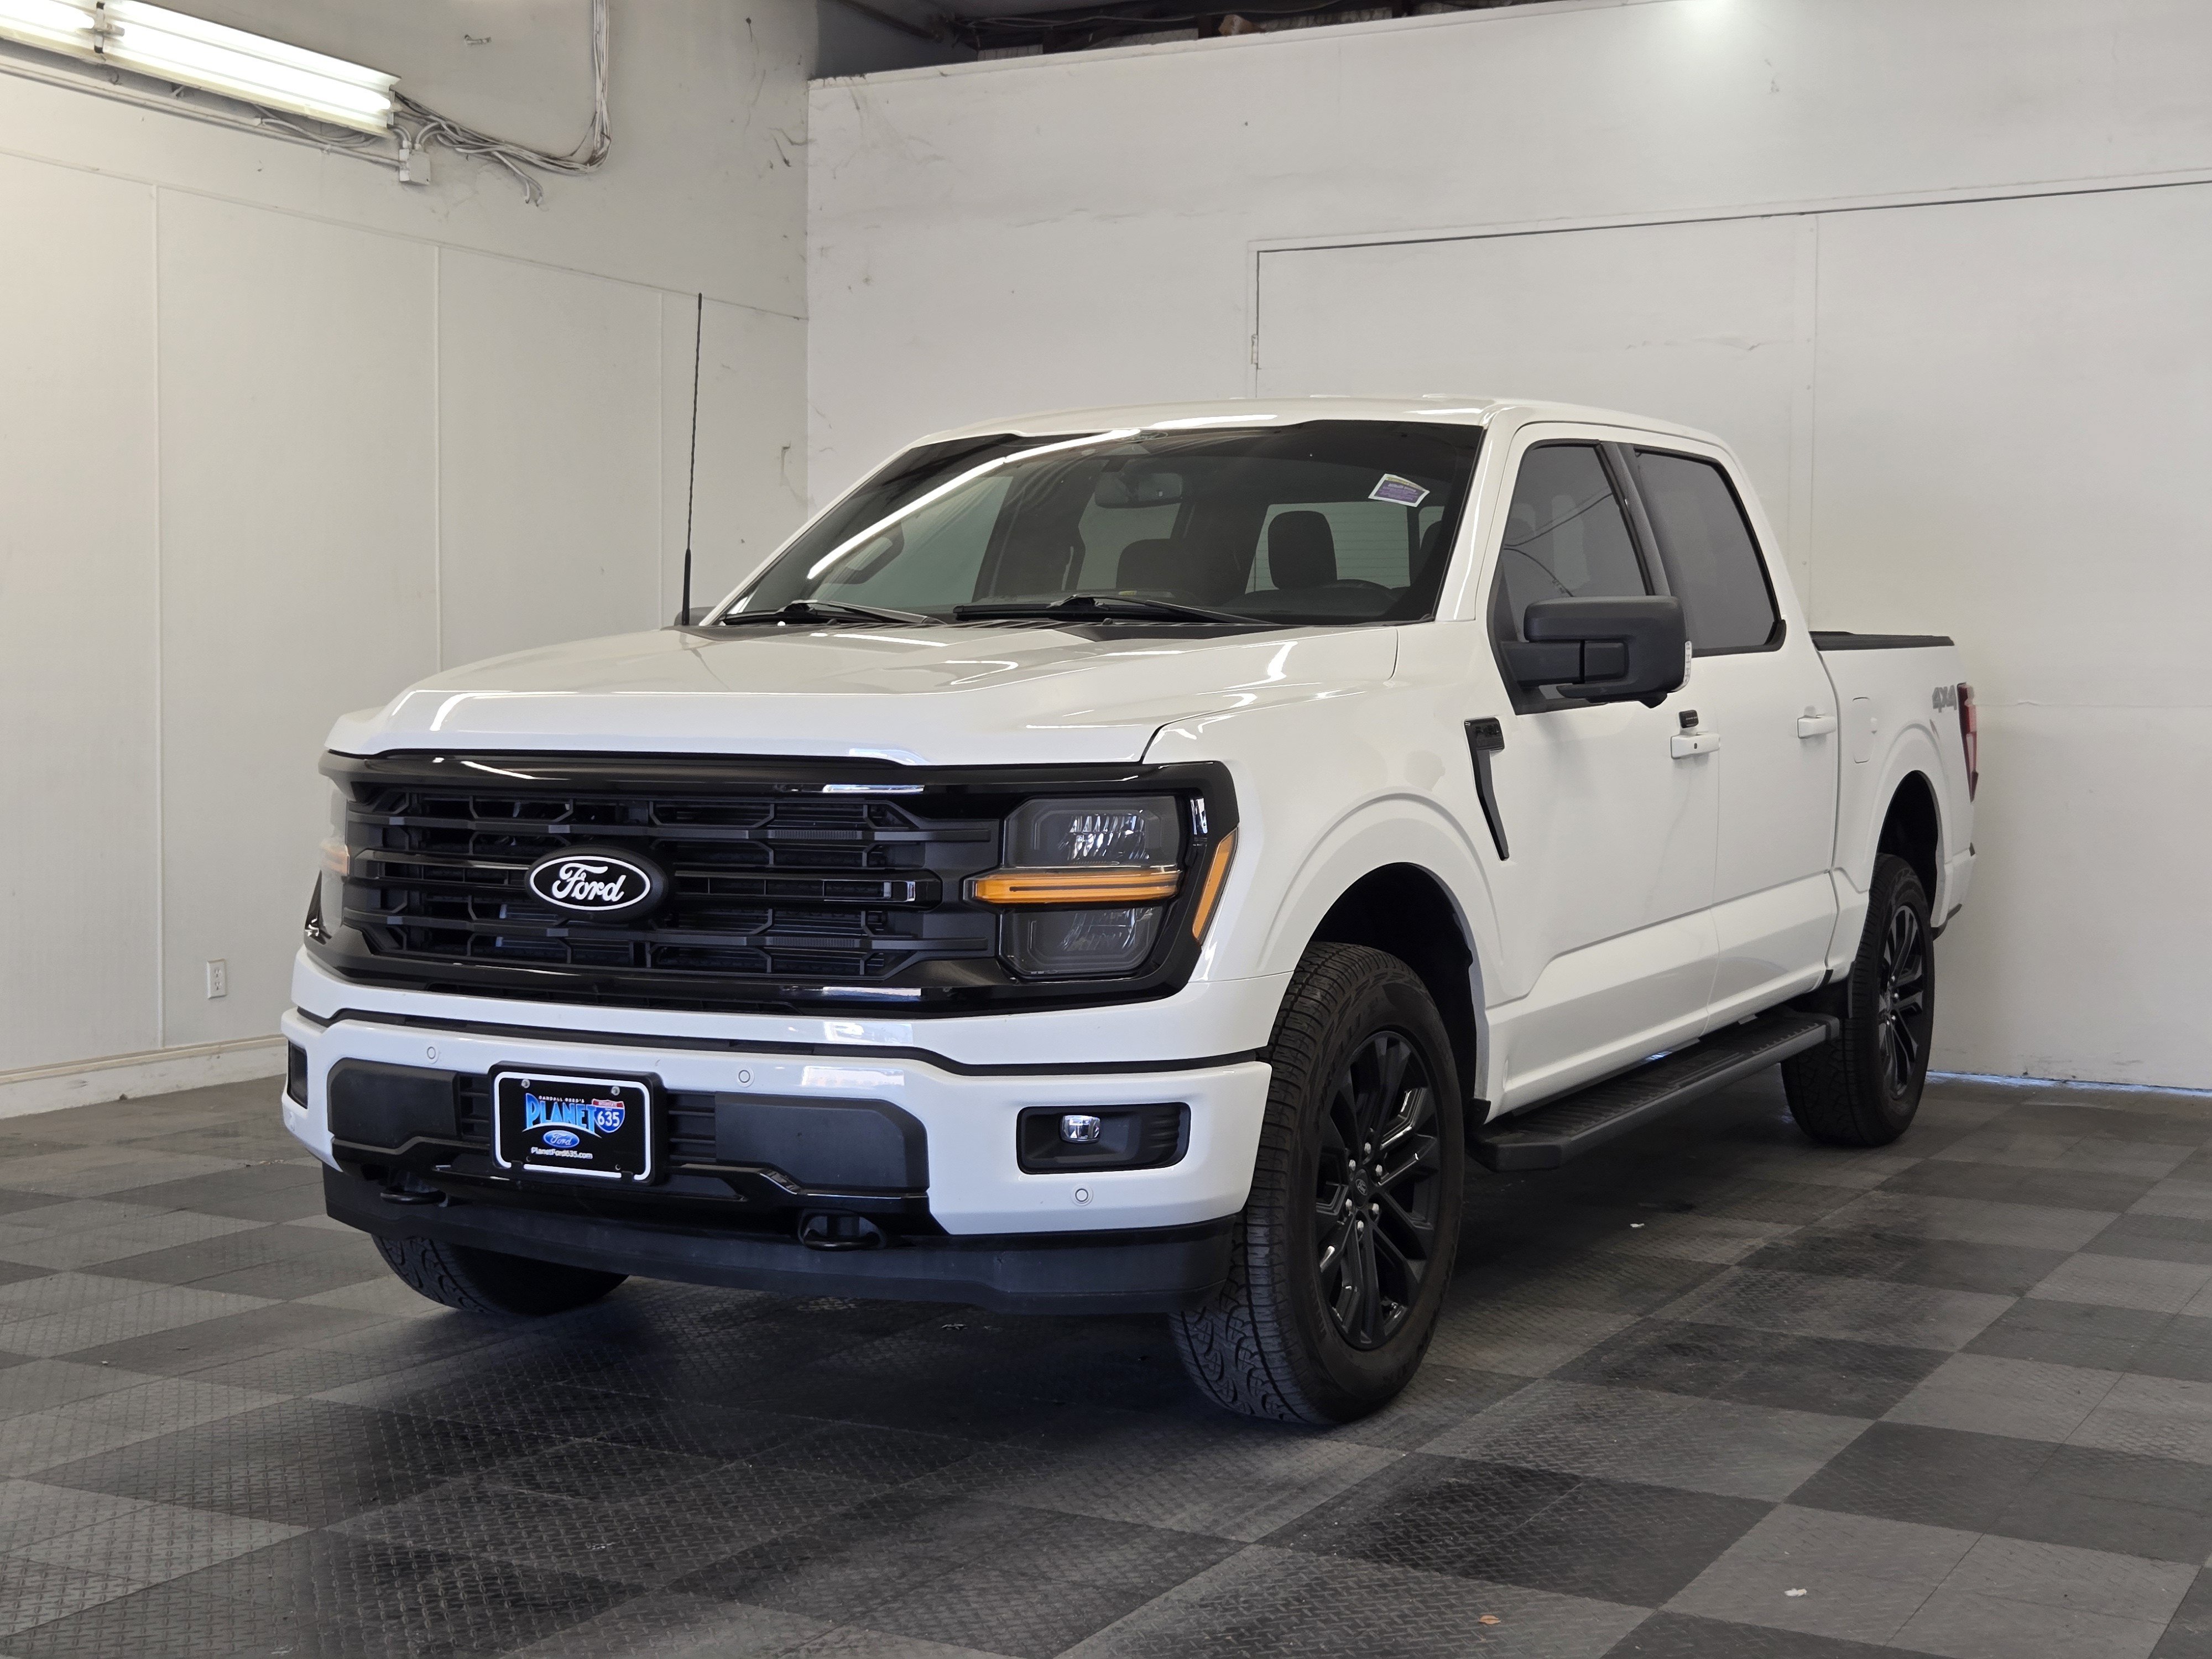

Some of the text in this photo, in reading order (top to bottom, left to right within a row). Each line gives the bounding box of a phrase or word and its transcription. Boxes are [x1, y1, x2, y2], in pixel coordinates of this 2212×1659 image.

[552, 863, 627, 902] Ford
[525, 1093, 620, 1133] PLANET 635
[550, 1133, 573, 1145] Ford
